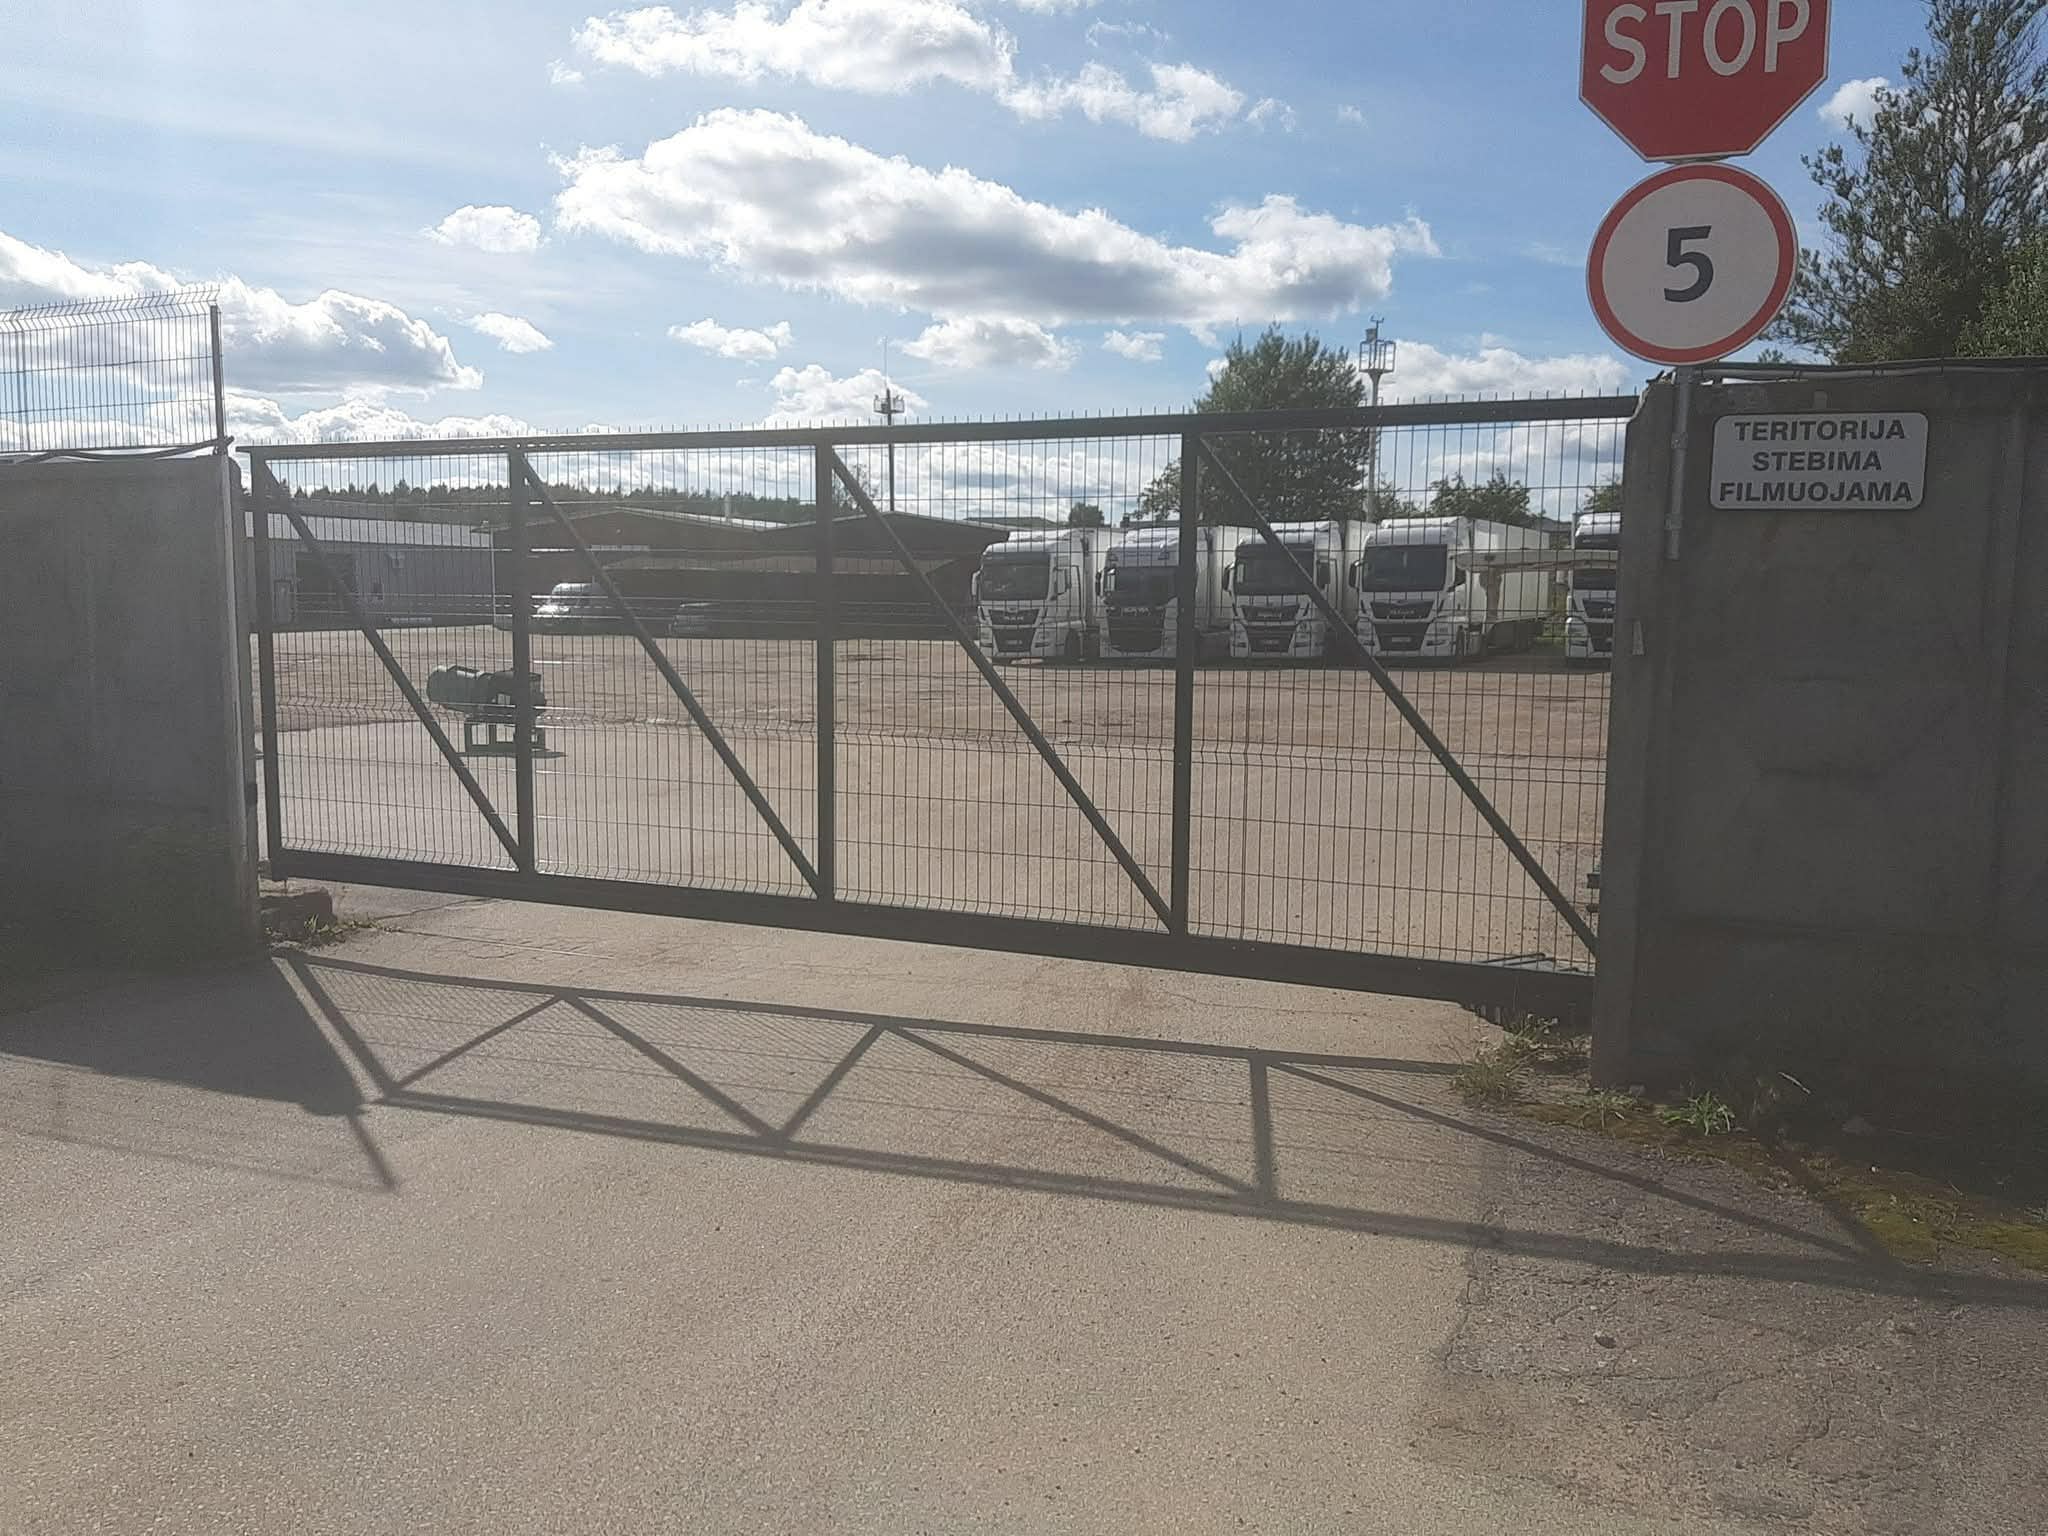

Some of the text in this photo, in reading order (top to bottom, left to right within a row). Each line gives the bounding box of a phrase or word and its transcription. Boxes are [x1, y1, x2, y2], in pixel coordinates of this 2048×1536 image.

[1600, 0, 1810, 85] STOP
[1663, 225, 1715, 303] 5
[1734, 419, 1906, 442] TERITORIJA
[1752, 450, 1882, 472] STEBIMA
[1719, 481, 1913, 502] FILMUOJAMA
